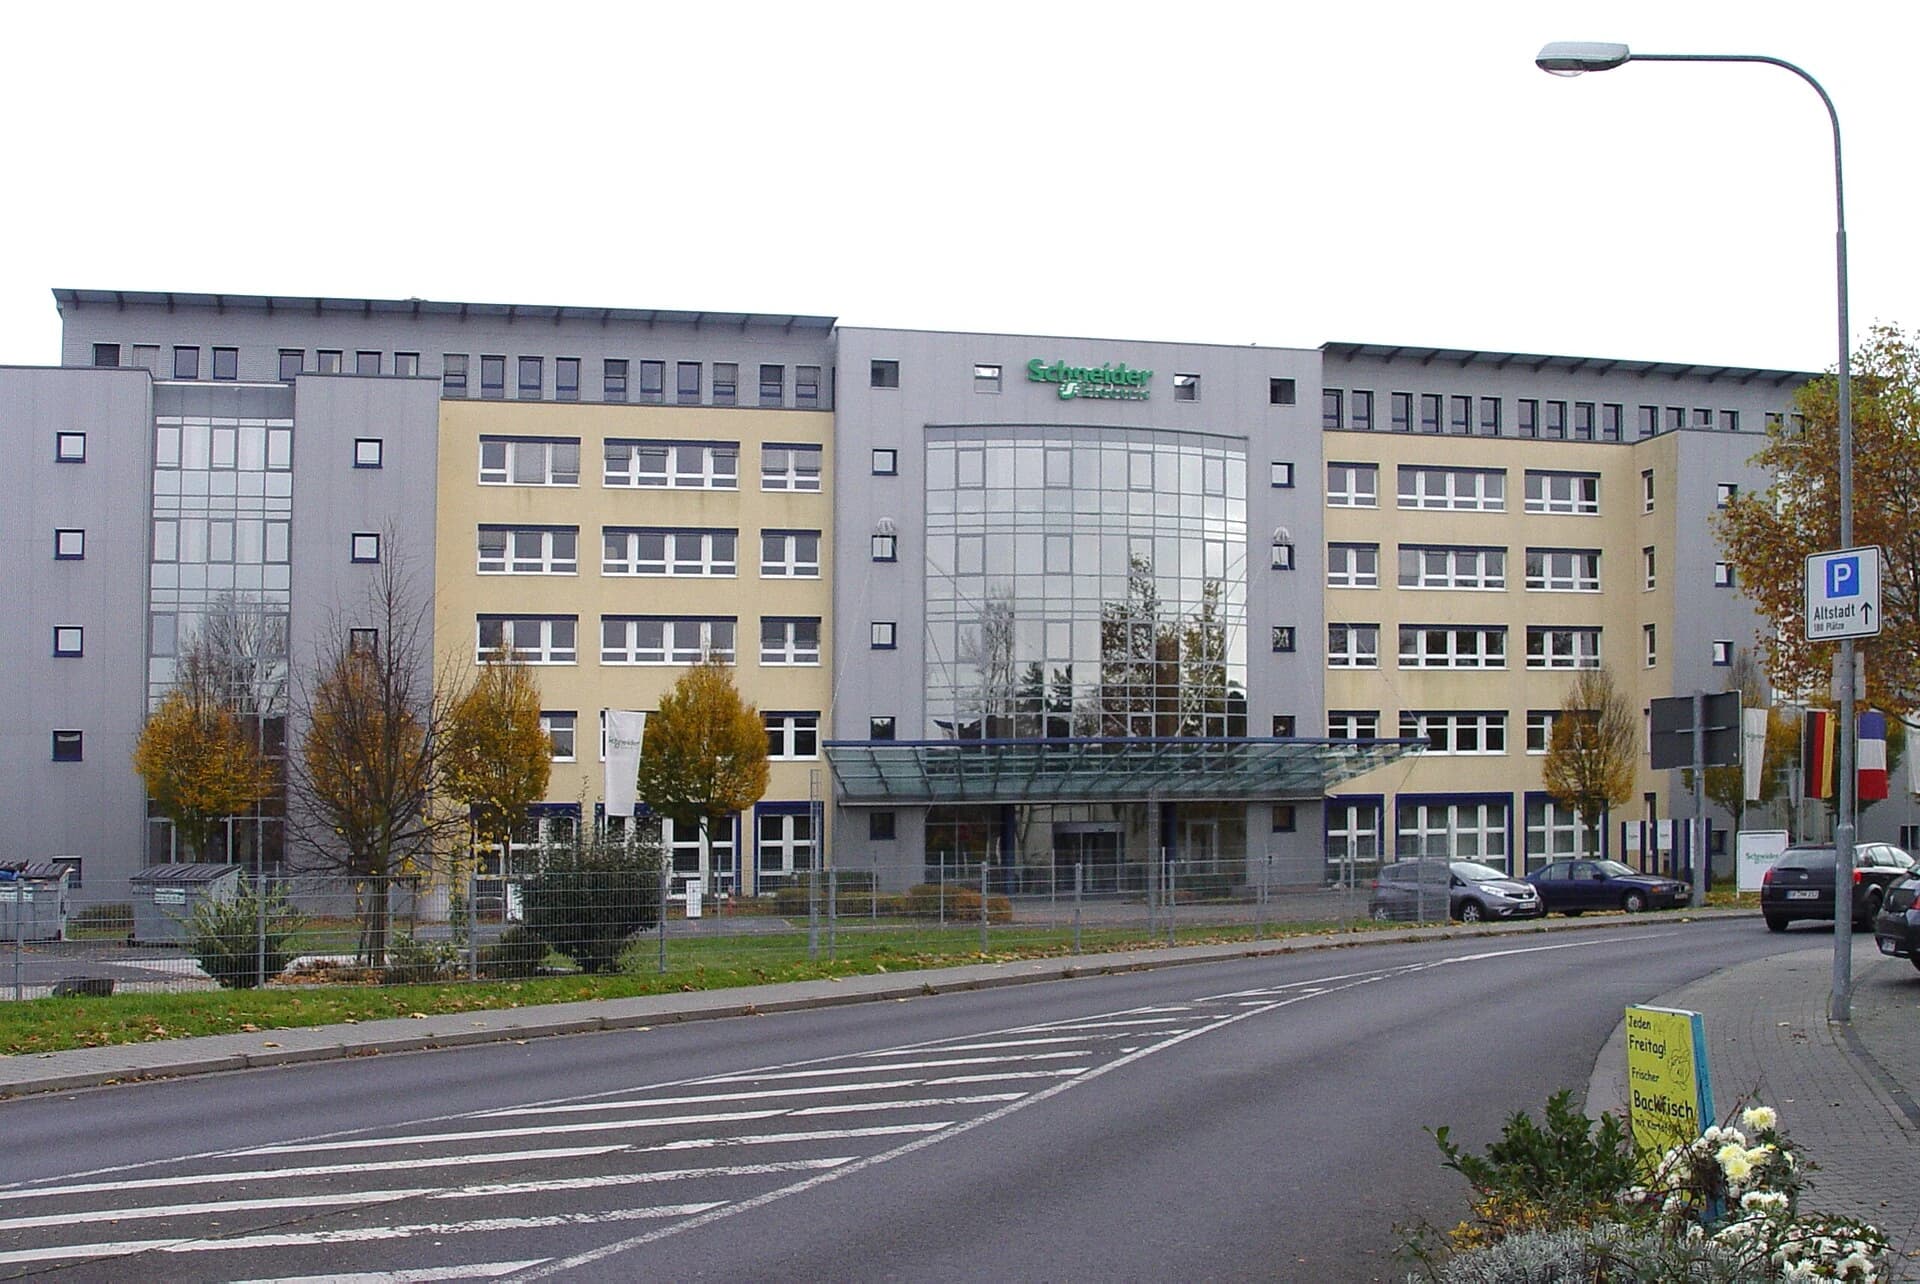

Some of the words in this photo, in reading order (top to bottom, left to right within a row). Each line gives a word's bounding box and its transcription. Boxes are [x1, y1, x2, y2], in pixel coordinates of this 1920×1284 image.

[1027, 358, 1153, 385] Schneider
[1833, 563, 1852, 593] P
[1813, 603, 1856, 621] Altstadt
[1628, 1015, 1651, 1030] Jeden
[1629, 1034, 1667, 1060] Freitag!
[1631, 1066, 1660, 1082] Frischer
[1633, 1089, 1694, 1120] Backfisch
